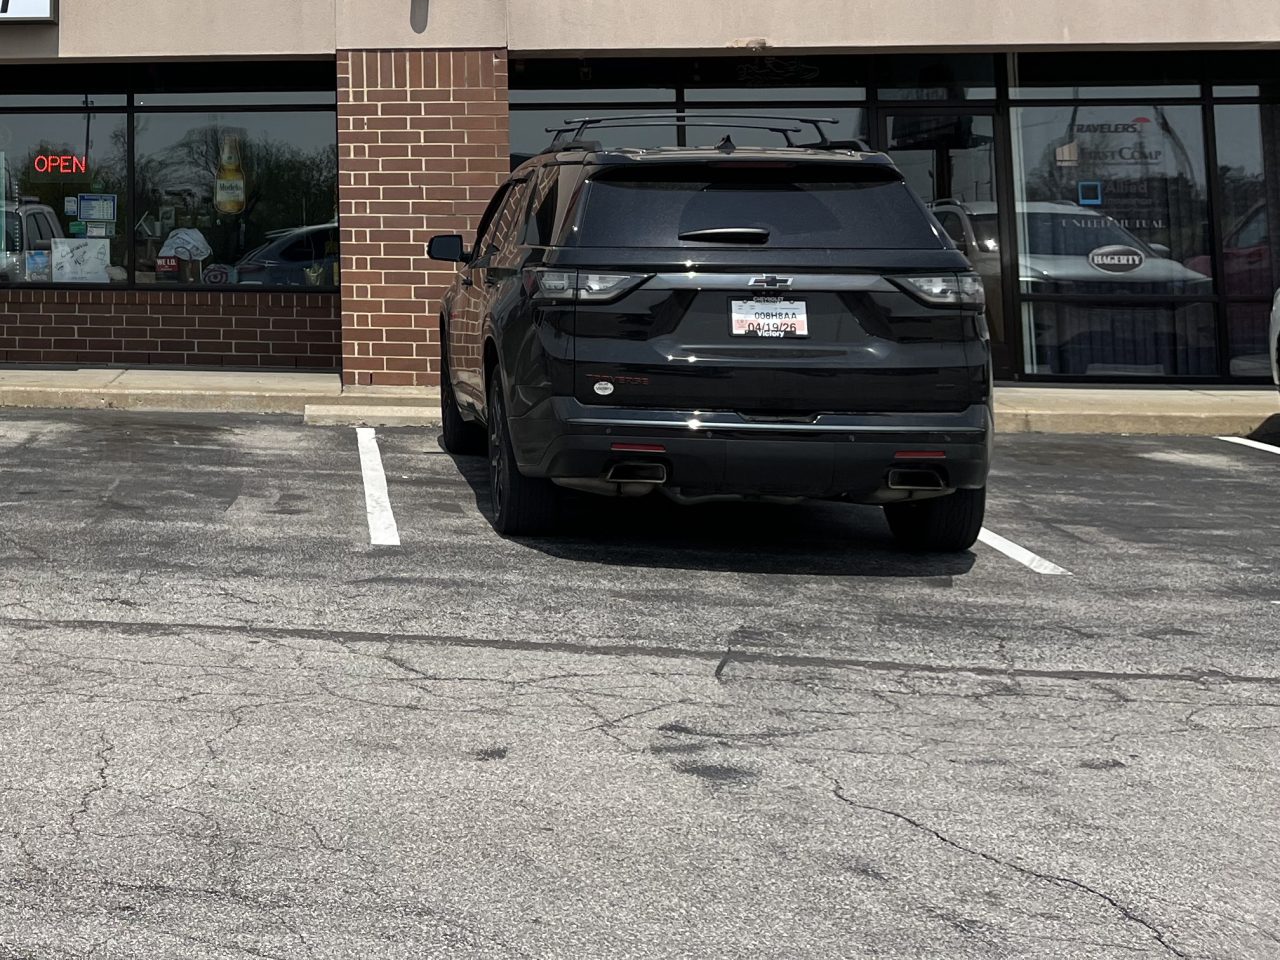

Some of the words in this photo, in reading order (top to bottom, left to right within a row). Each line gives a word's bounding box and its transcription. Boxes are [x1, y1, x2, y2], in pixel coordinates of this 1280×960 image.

[34, 155, 87, 173] OPEN
[1093, 255, 1141, 265] HAGERTY
[747, 322, 797, 331] 04/19/26
[756, 329, 785, 338] Victory
